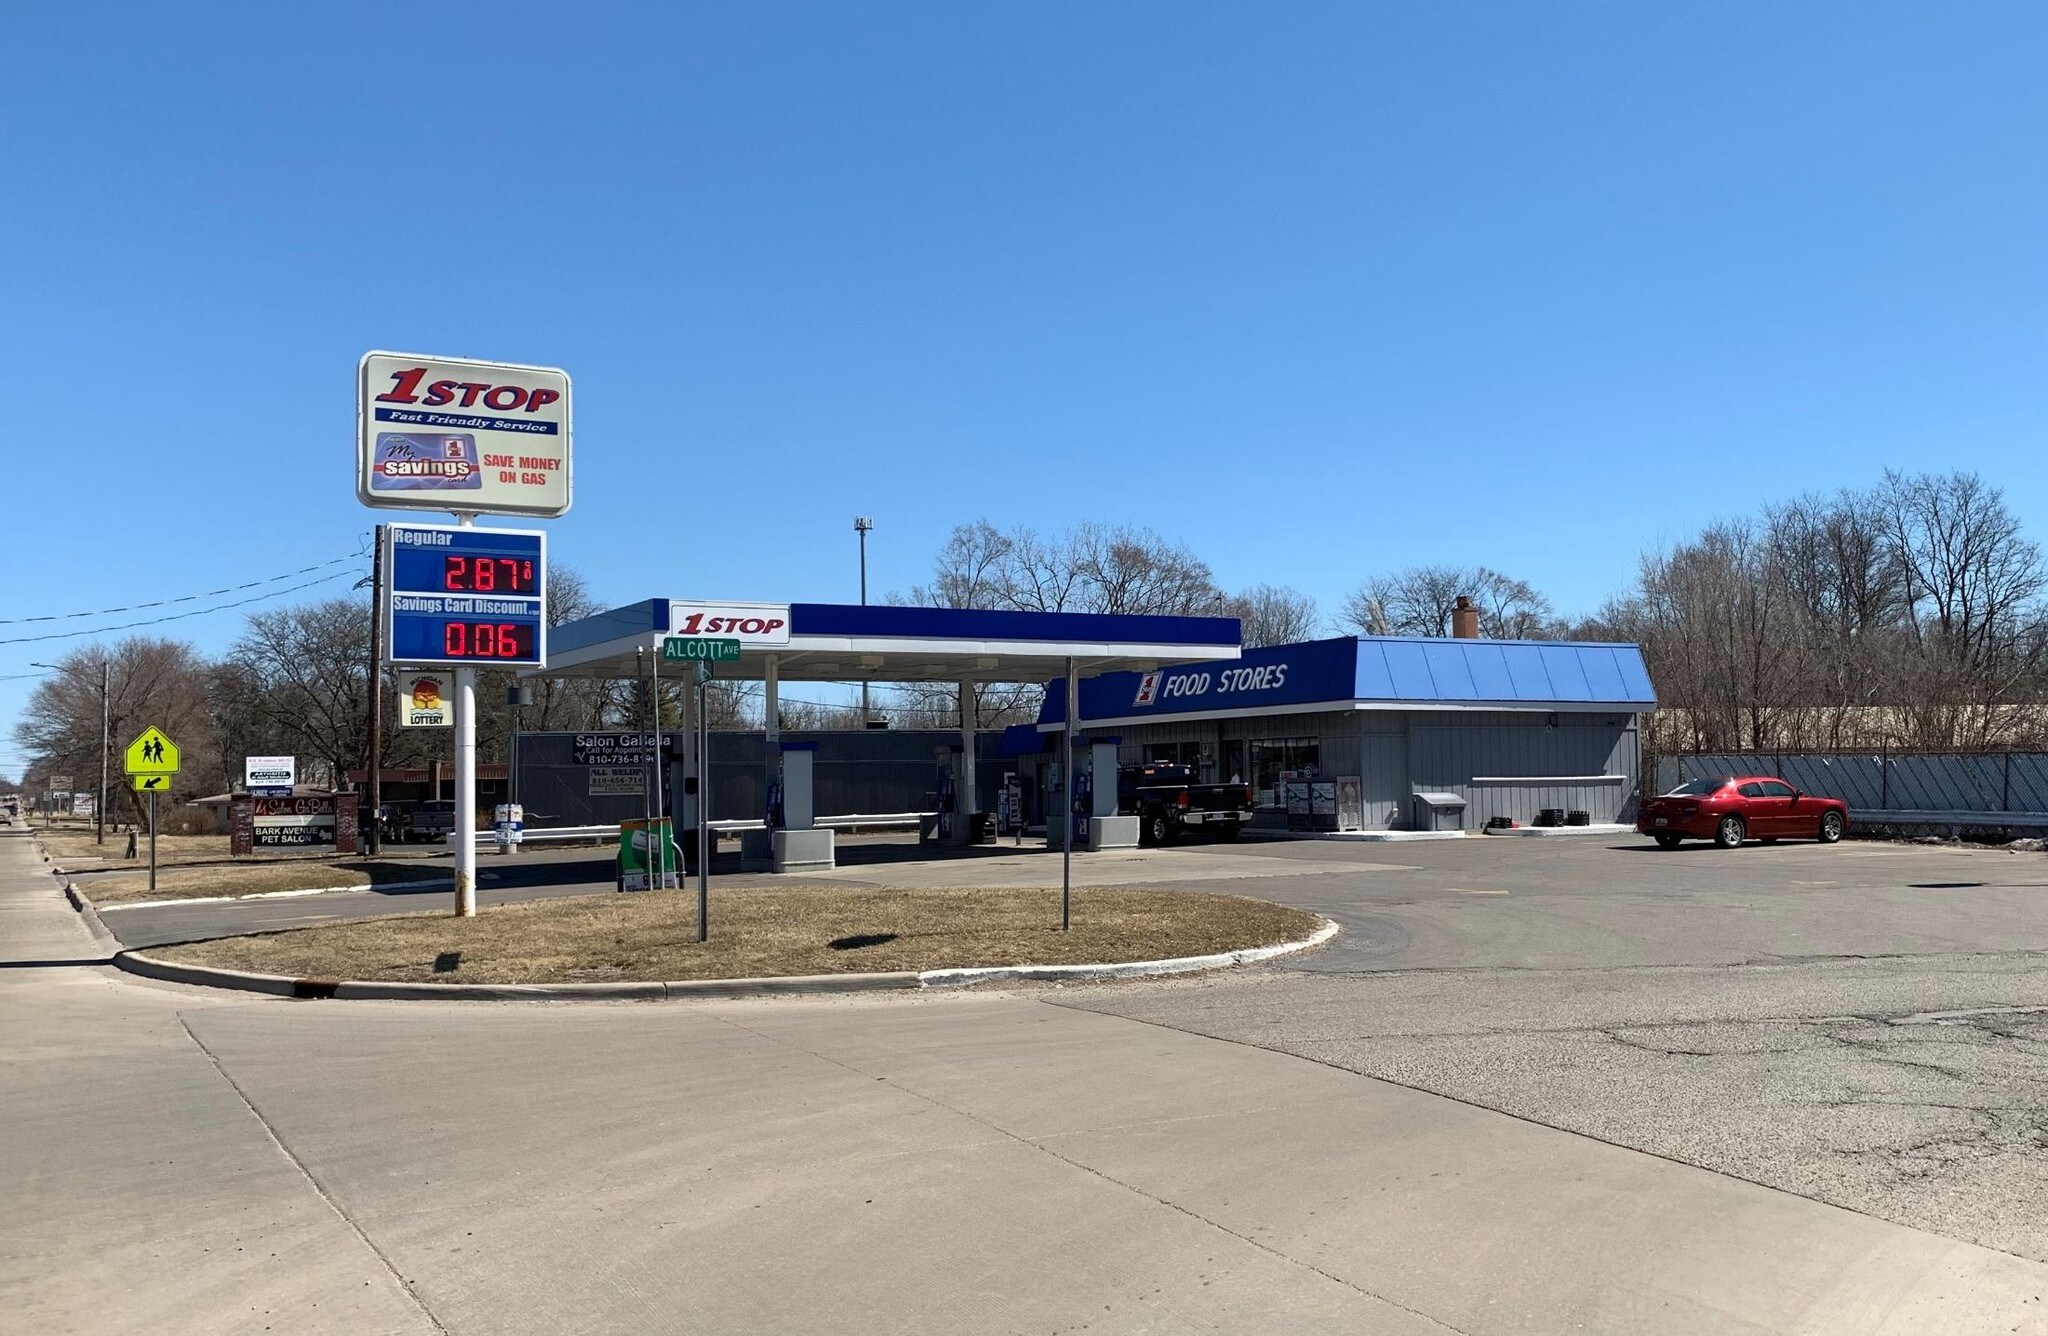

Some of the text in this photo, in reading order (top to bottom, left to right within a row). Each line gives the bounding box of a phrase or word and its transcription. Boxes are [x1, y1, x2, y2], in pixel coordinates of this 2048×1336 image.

[389, 411, 548, 432] Fast Friendly Service
[387, 445, 416, 461] My
[384, 459, 470, 477] savings
[483, 454, 561, 470] SAVE MONEY
[499, 470, 546, 485] ON GAS
[394, 529, 452, 546] Regular
[394, 596, 442, 613] Savings
[444, 597, 473, 613] Card
[475, 599, 528, 615] Discount
[446, 623, 517, 656] 0.06
[666, 641, 738, 658] ALCOTT AVE
[1163, 663, 1288, 698] FOOD STORES
[410, 715, 443, 724] LOTTERY
[576, 734, 671, 747] Salon GaBela
[255, 826, 318, 836] BARK AVENUE
[261, 835, 312, 844] PET SALON
